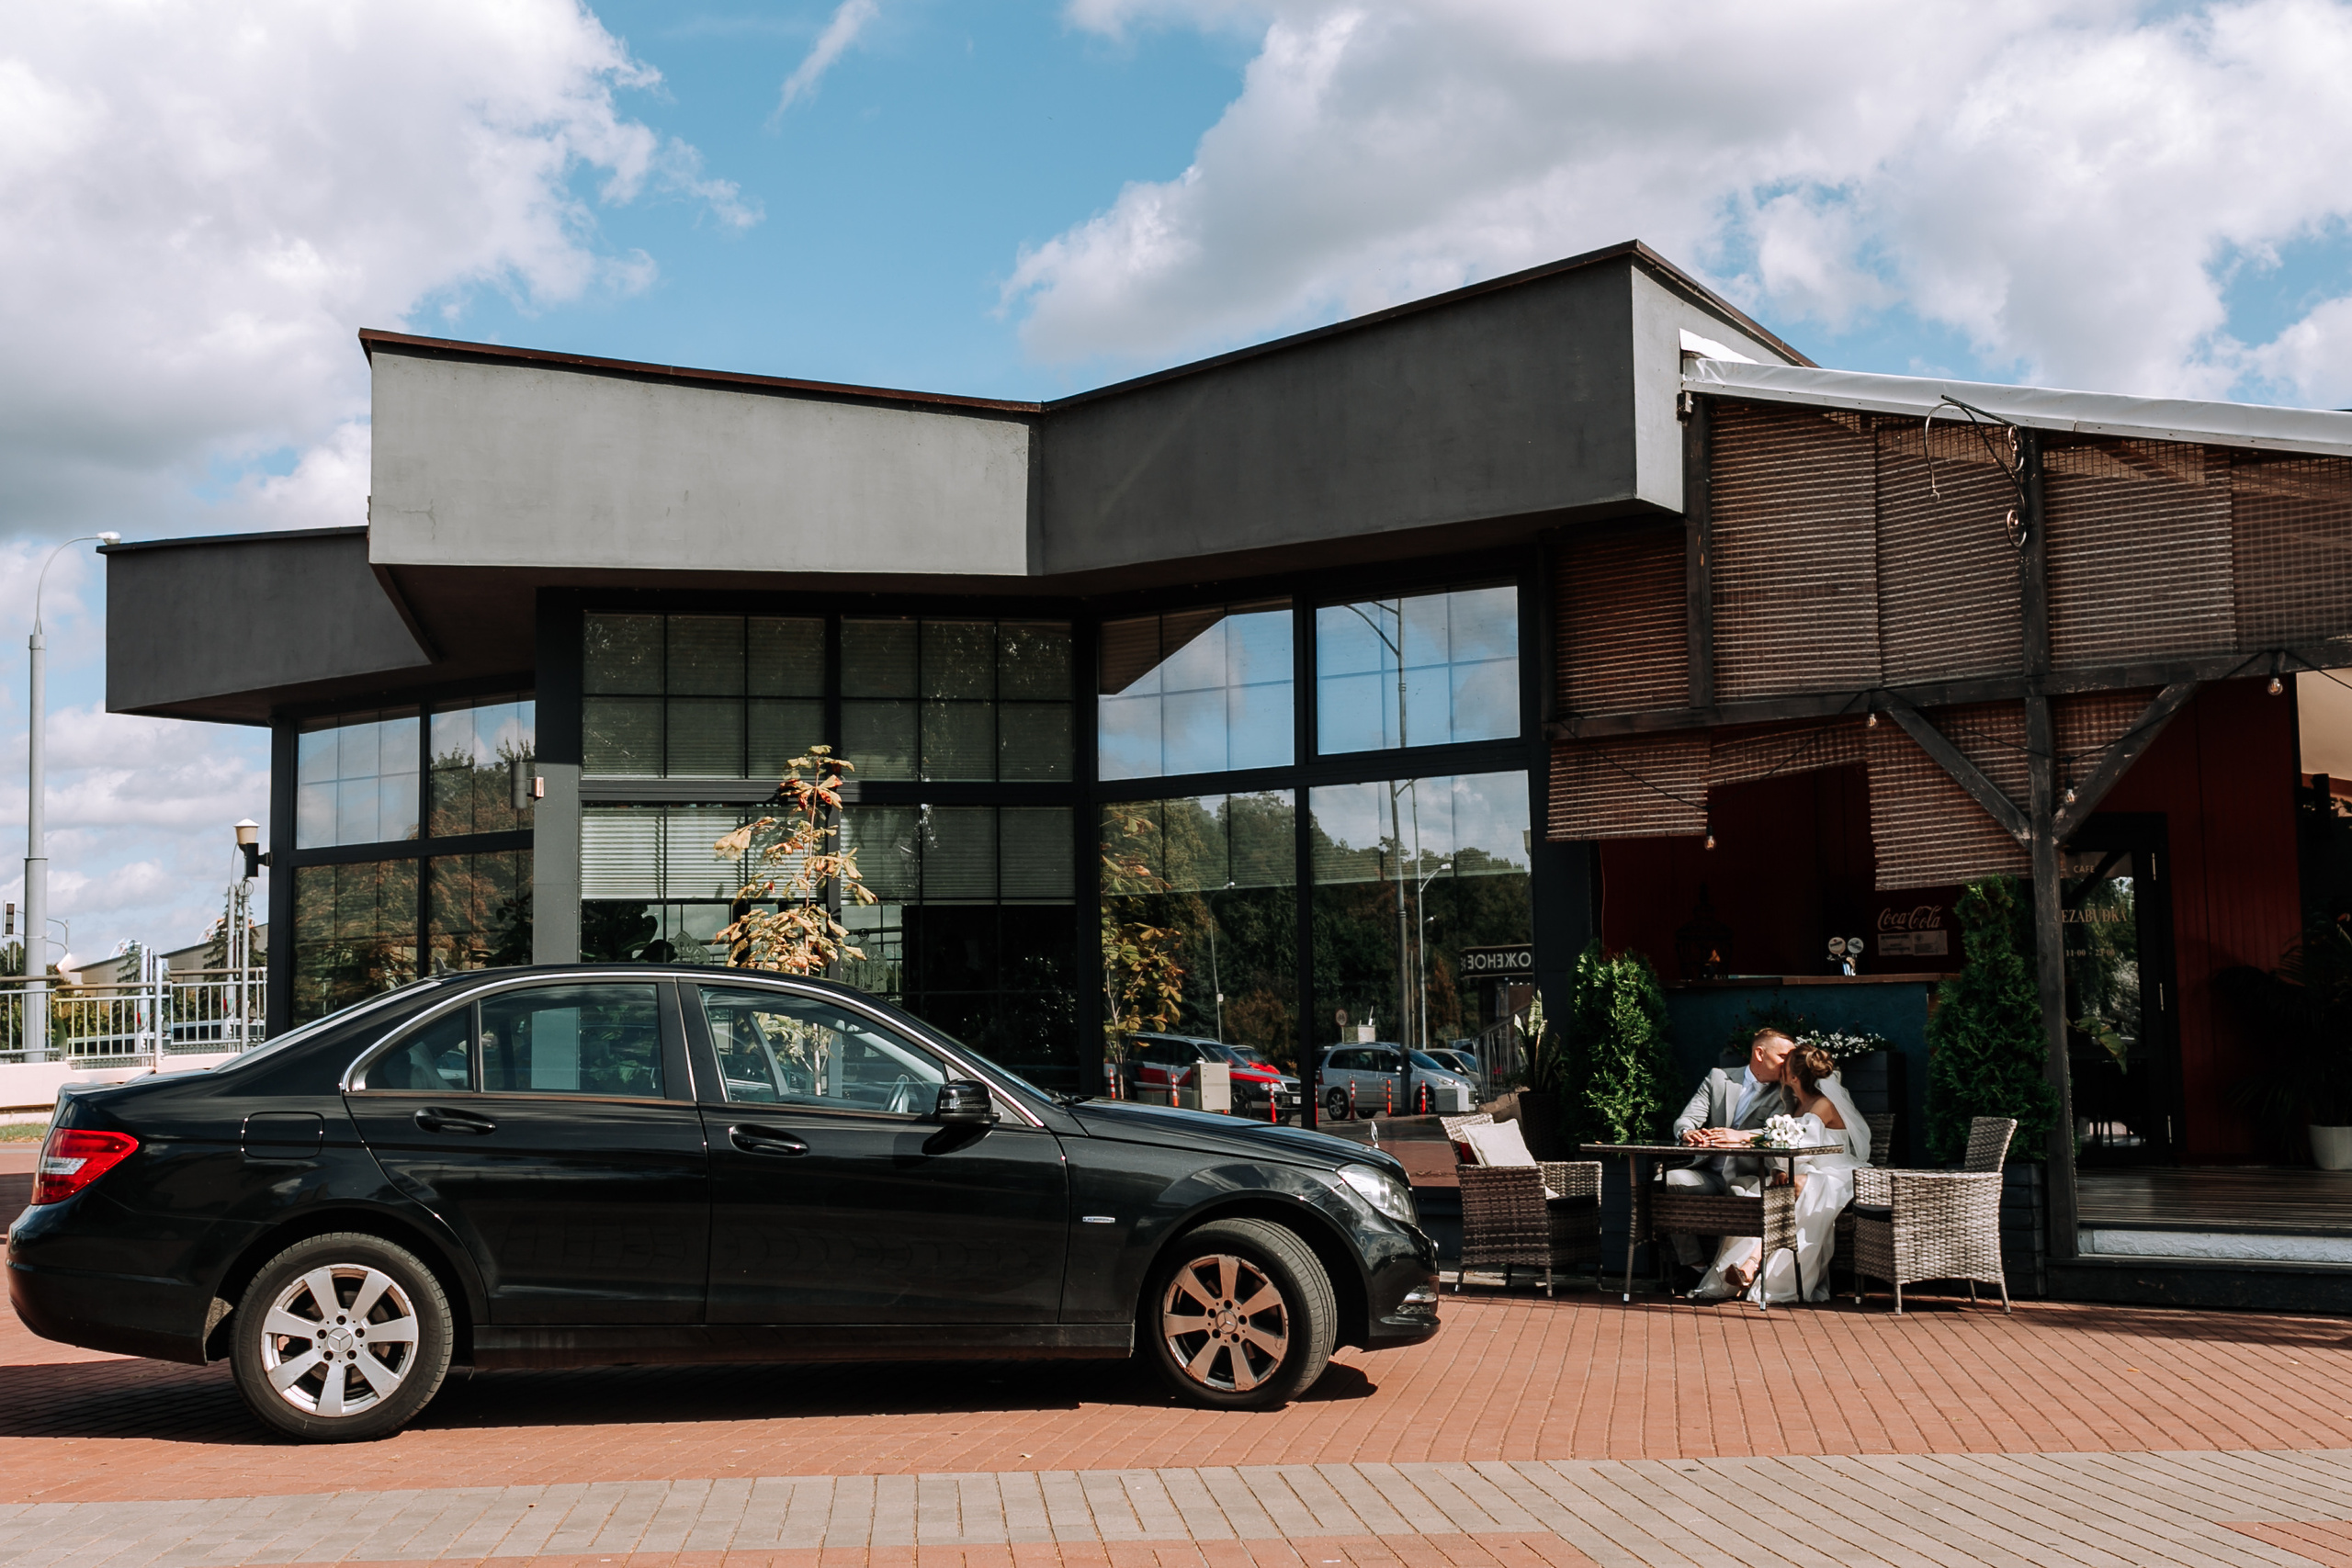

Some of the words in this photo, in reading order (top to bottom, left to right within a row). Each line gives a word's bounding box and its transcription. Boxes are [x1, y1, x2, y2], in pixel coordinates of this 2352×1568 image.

[2074, 865, 2095, 874] CAFE
[1877, 905, 1943, 931] Coca-Cola
[2061, 908, 2127, 923] EZABUDKA
